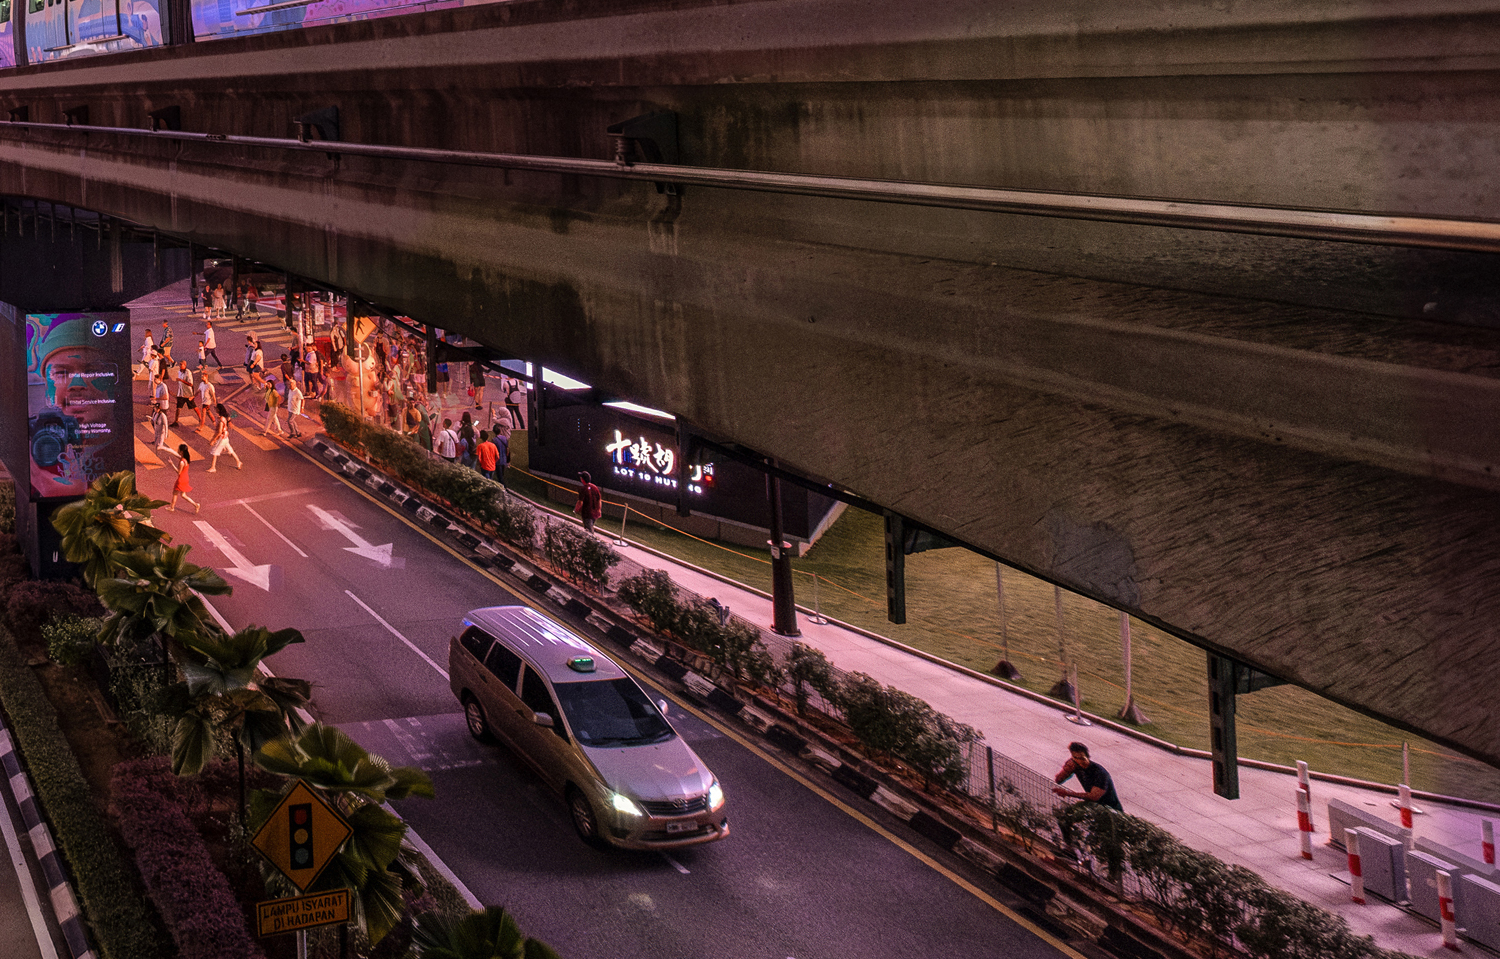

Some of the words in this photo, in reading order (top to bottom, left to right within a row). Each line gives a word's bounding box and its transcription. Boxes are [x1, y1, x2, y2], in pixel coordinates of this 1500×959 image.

[614, 466, 635, 477] LOT
[638, 472, 651, 481] 10
[654, 476, 702, 494] HUTNG
[263, 902, 299, 919] LAMPU
[302, 895, 343, 910] ISYARAT
[274, 918, 285, 931] DI
[287, 909, 335, 927] HADAPAN
